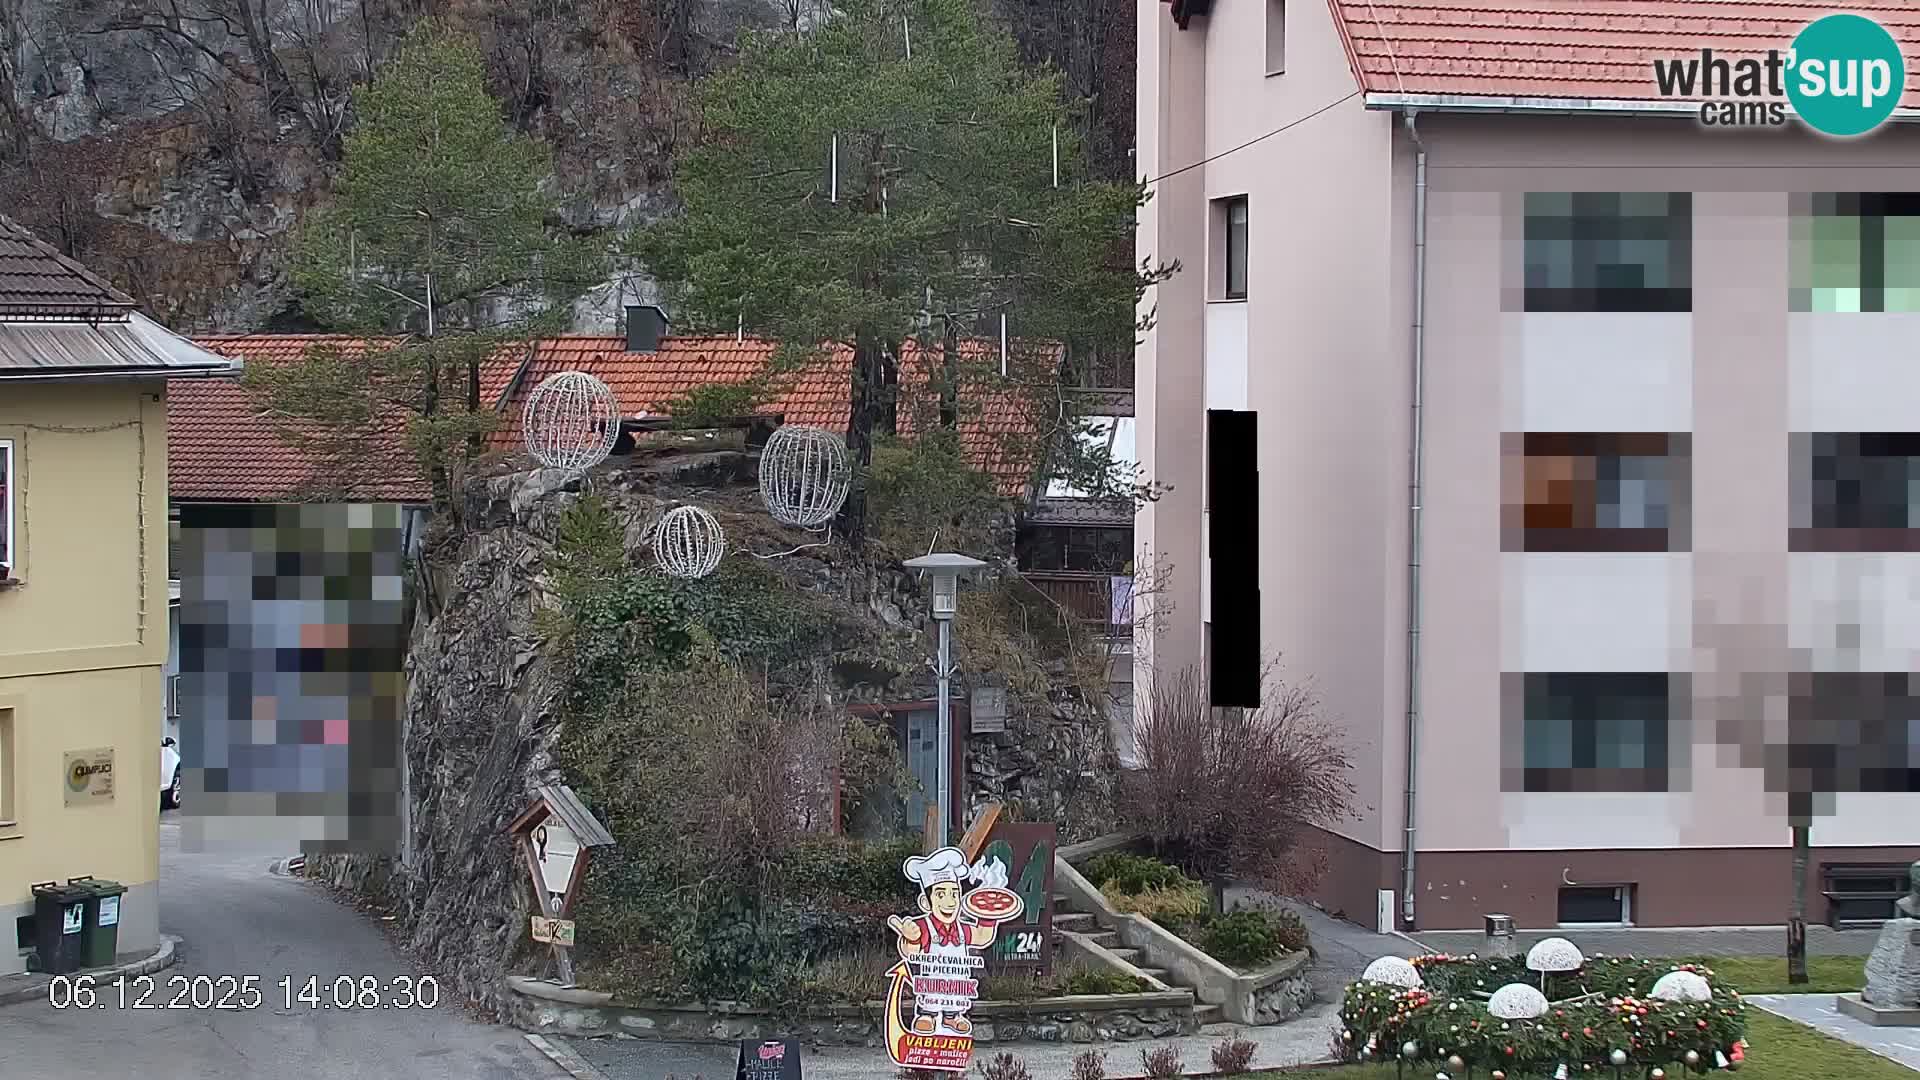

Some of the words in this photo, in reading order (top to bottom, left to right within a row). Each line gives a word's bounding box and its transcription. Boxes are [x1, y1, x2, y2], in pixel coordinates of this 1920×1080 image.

[922, 964, 931, 974] IN
[932, 966, 970, 976] PICERIJA
[906, 1036, 972, 1050] VABLJENI
